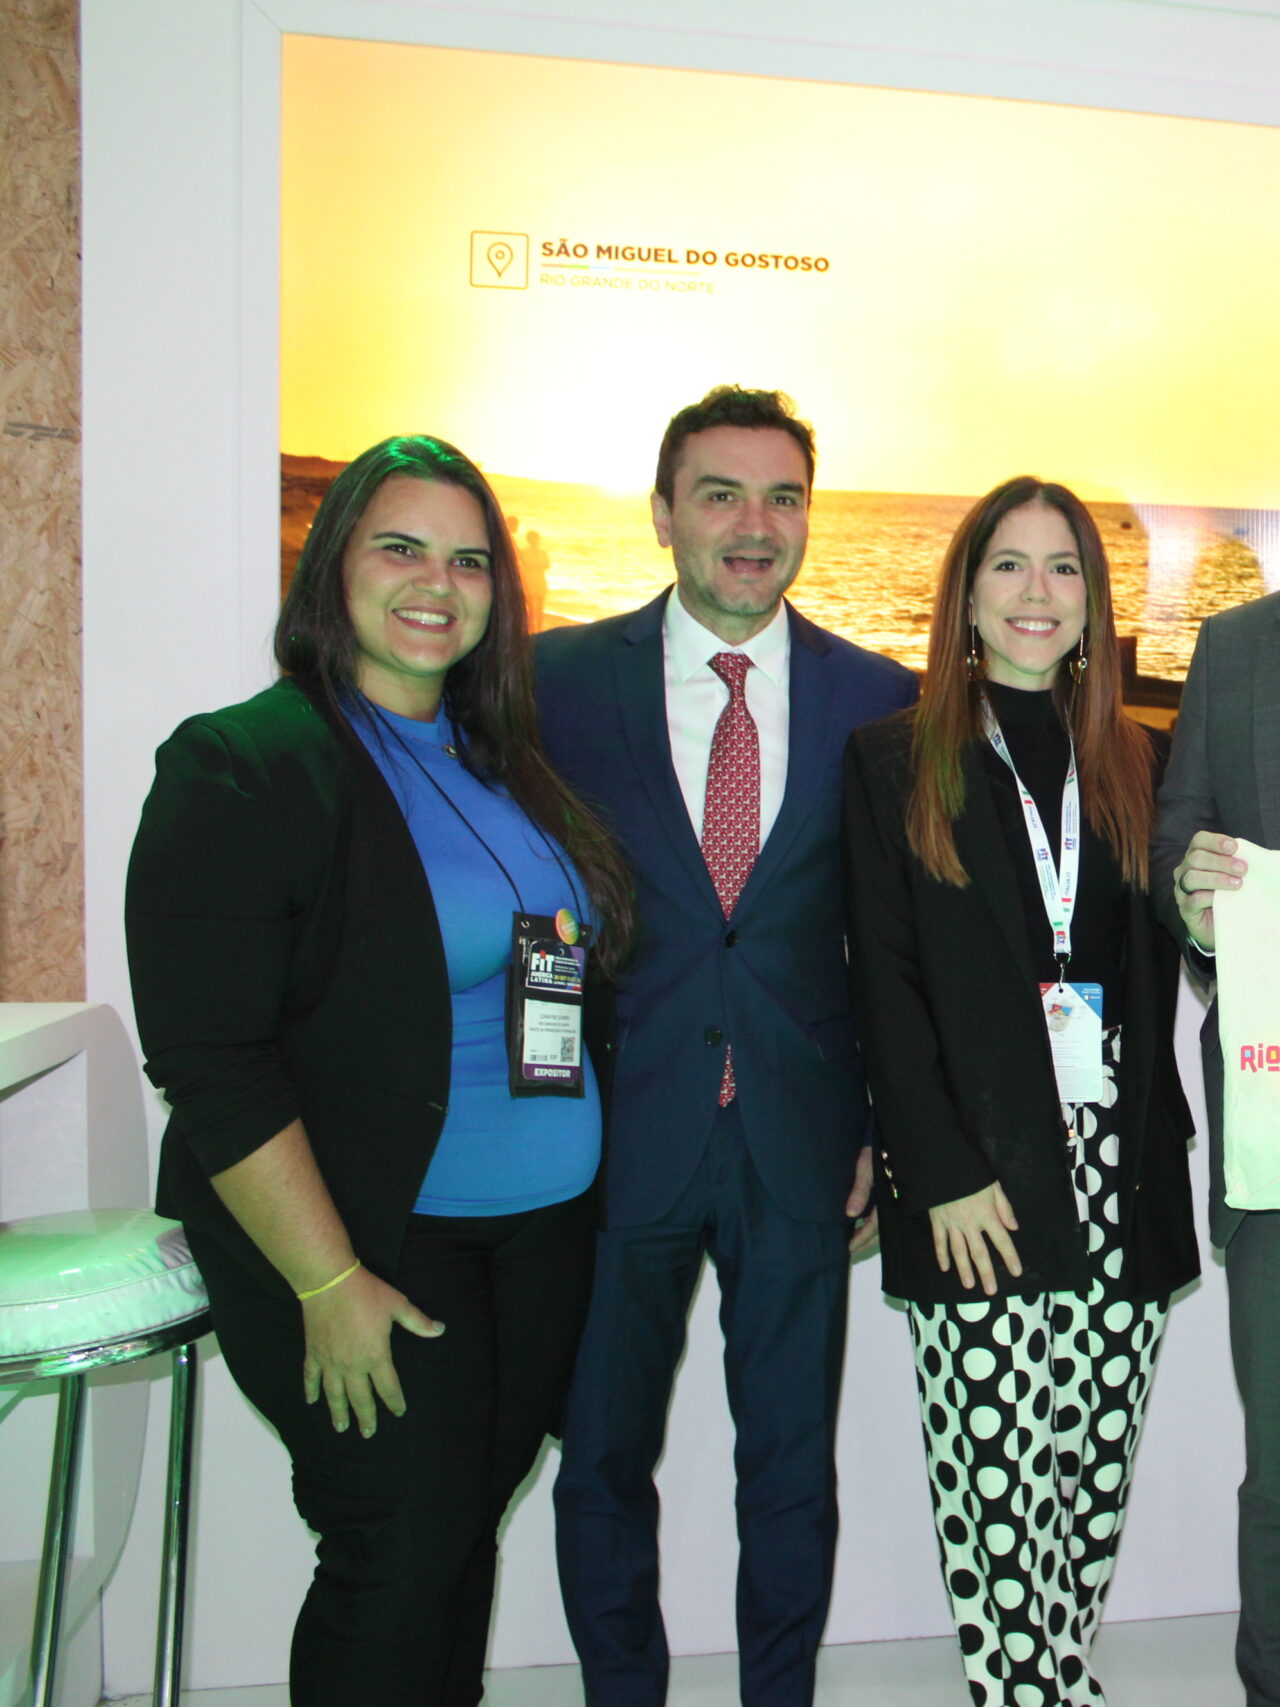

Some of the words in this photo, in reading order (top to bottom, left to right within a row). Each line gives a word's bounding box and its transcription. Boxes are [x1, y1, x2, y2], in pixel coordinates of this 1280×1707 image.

[541, 238, 588, 259] SÃO
[596, 244, 679, 264] MIGUEL
[686, 249, 717, 266] DO
[725, 251, 830, 273] GOSTOSO
[540, 273, 566, 287] RIO
[570, 275, 633, 289] GRANDE
[638, 278, 660, 291] DO
[665, 280, 716, 295] NORTE
[534, 1068, 571, 1078] EXPOSITOR
